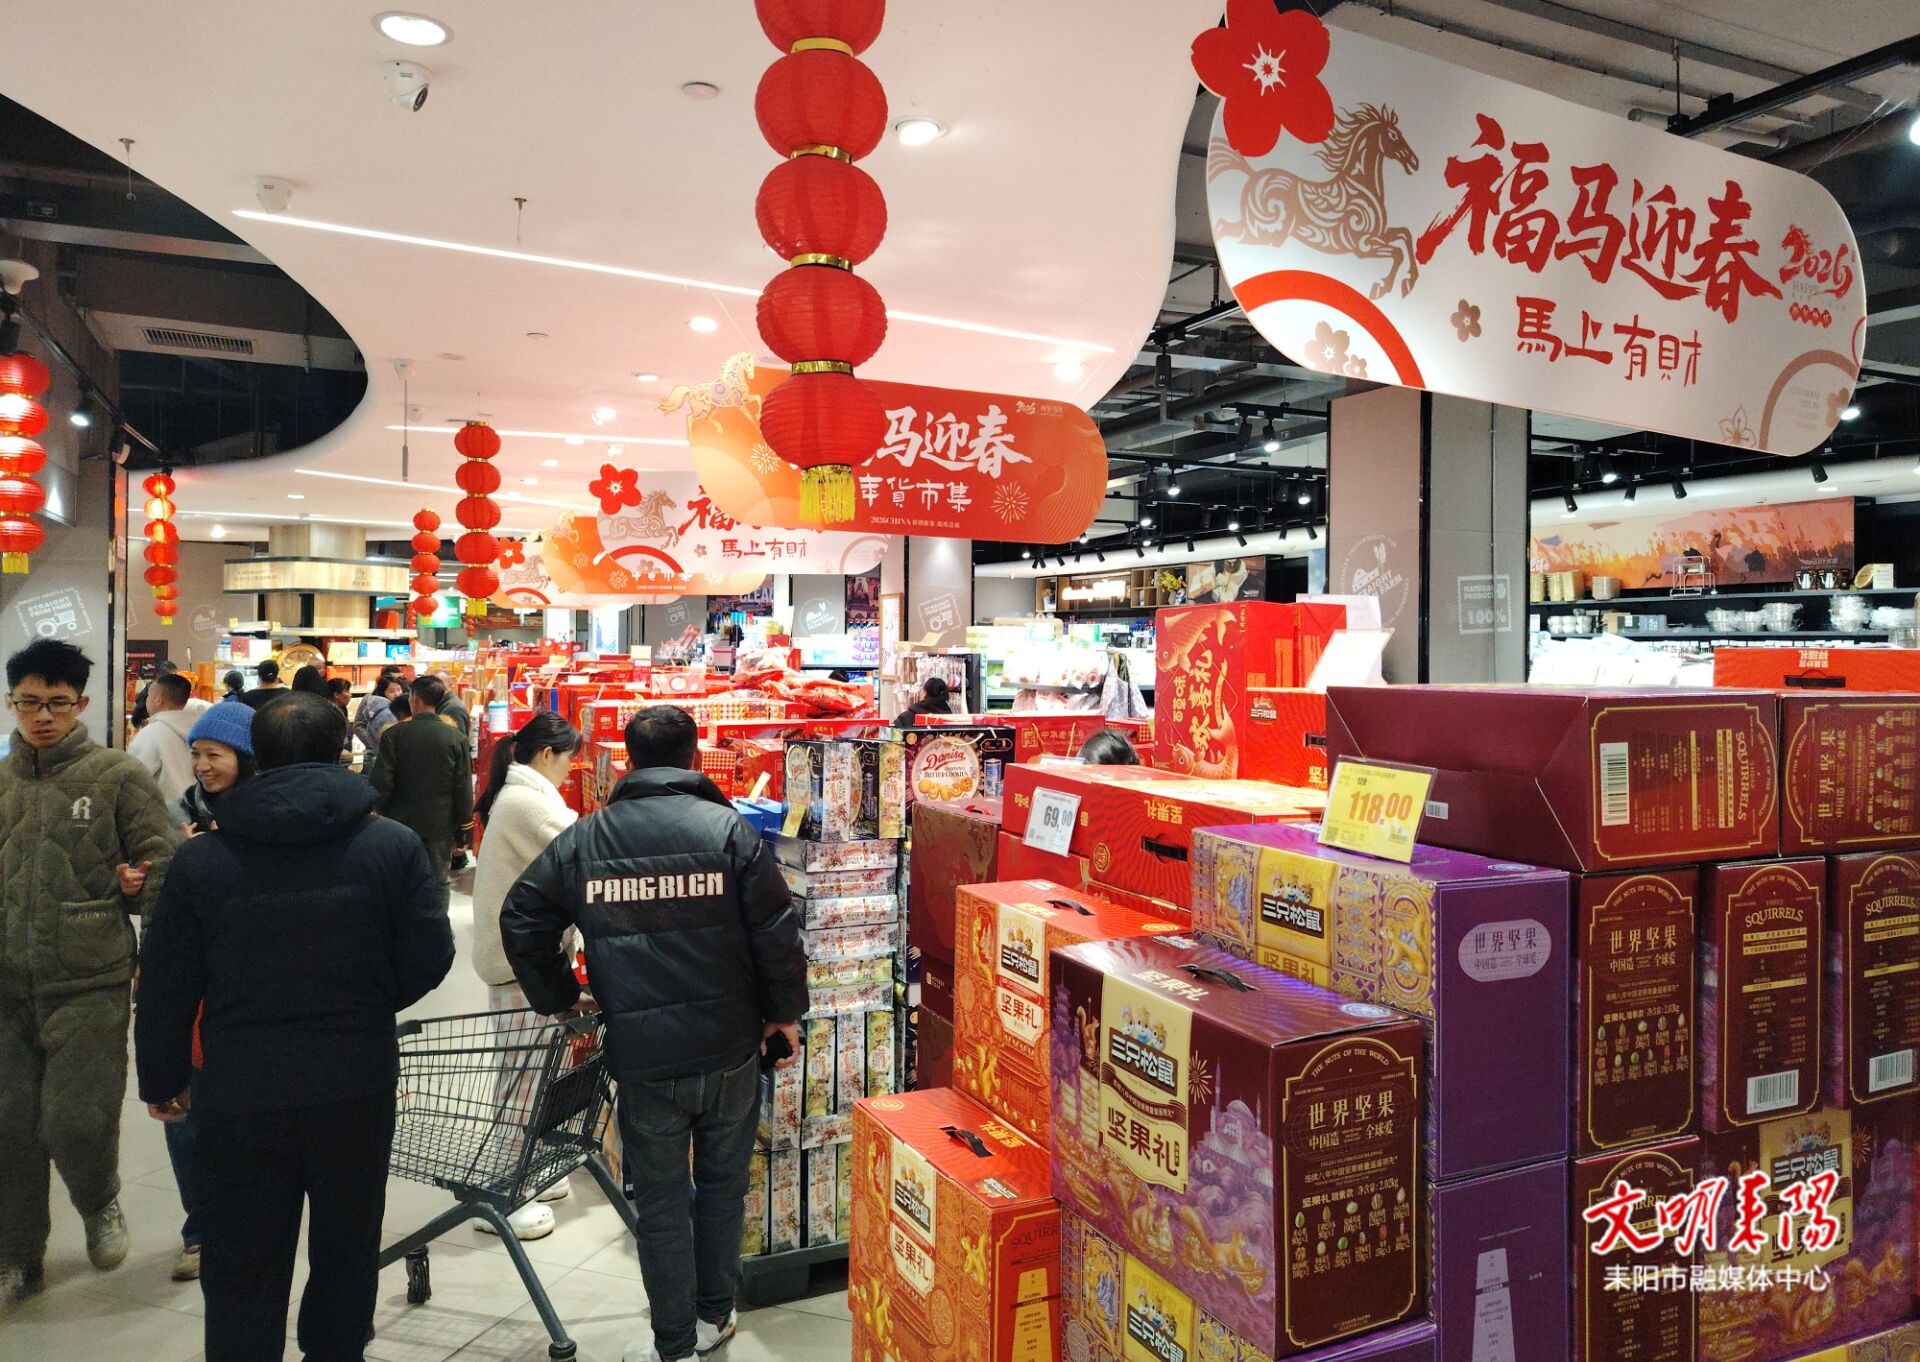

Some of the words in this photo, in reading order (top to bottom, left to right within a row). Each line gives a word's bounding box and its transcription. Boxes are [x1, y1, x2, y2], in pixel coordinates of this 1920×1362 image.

[1416, 113, 1783, 323] 福马迎春
[1779, 224, 1854, 299] 2026
[861, 404, 1034, 479] 马迎春
[739, 587, 773, 604] CLEA
[1464, 585, 1493, 593] NATURA
[1467, 608, 1506, 625] 100%
[1173, 675, 1187, 723] 百草味
[1187, 649, 1214, 751] 欢喜礼
[922, 749, 966, 772] Danisa
[1735, 731, 1750, 822] SQUIRRELS
[1818, 729, 1837, 818] 世界坚果
[1349, 791, 1413, 825] 118.00
[1262, 897, 1322, 932] 三只松鼠
[1745, 907, 1804, 928] SQUIRRELS
[1865, 895, 1917, 916] SQUIRRELS
[1474, 927, 1537, 954] 世界坚果
[1609, 924, 1677, 955] 世界坚果
[1002, 949, 1038, 978] 三只松鼠
[1132, 970, 1209, 1002] 坚果礼
[1001, 992, 1038, 1029] 坚果礼
[1110, 1034, 1175, 1088] 三只松鼠
[1311, 1064, 1324, 1078] THE
[1324, 1052, 1341, 1066] NUTS
[1343, 1048, 1352, 1057] OF
[1354, 1048, 1367, 1056] THE
[1369, 1049, 1390, 1066] WORLD
[1308, 1089, 1395, 1131] 世界坚果
[1106, 1106, 1178, 1177] 坚果礼
[1308, 1131, 1340, 1151] 中国造
[1366, 1119, 1394, 1140] 全球爱
[1656, 1163, 1674, 1177] WORLD
[1774, 1148, 1840, 1184] 三只松鼠
[895, 1184, 930, 1228] 三只松鼠
[894, 1231, 929, 1281] 坚果礼
